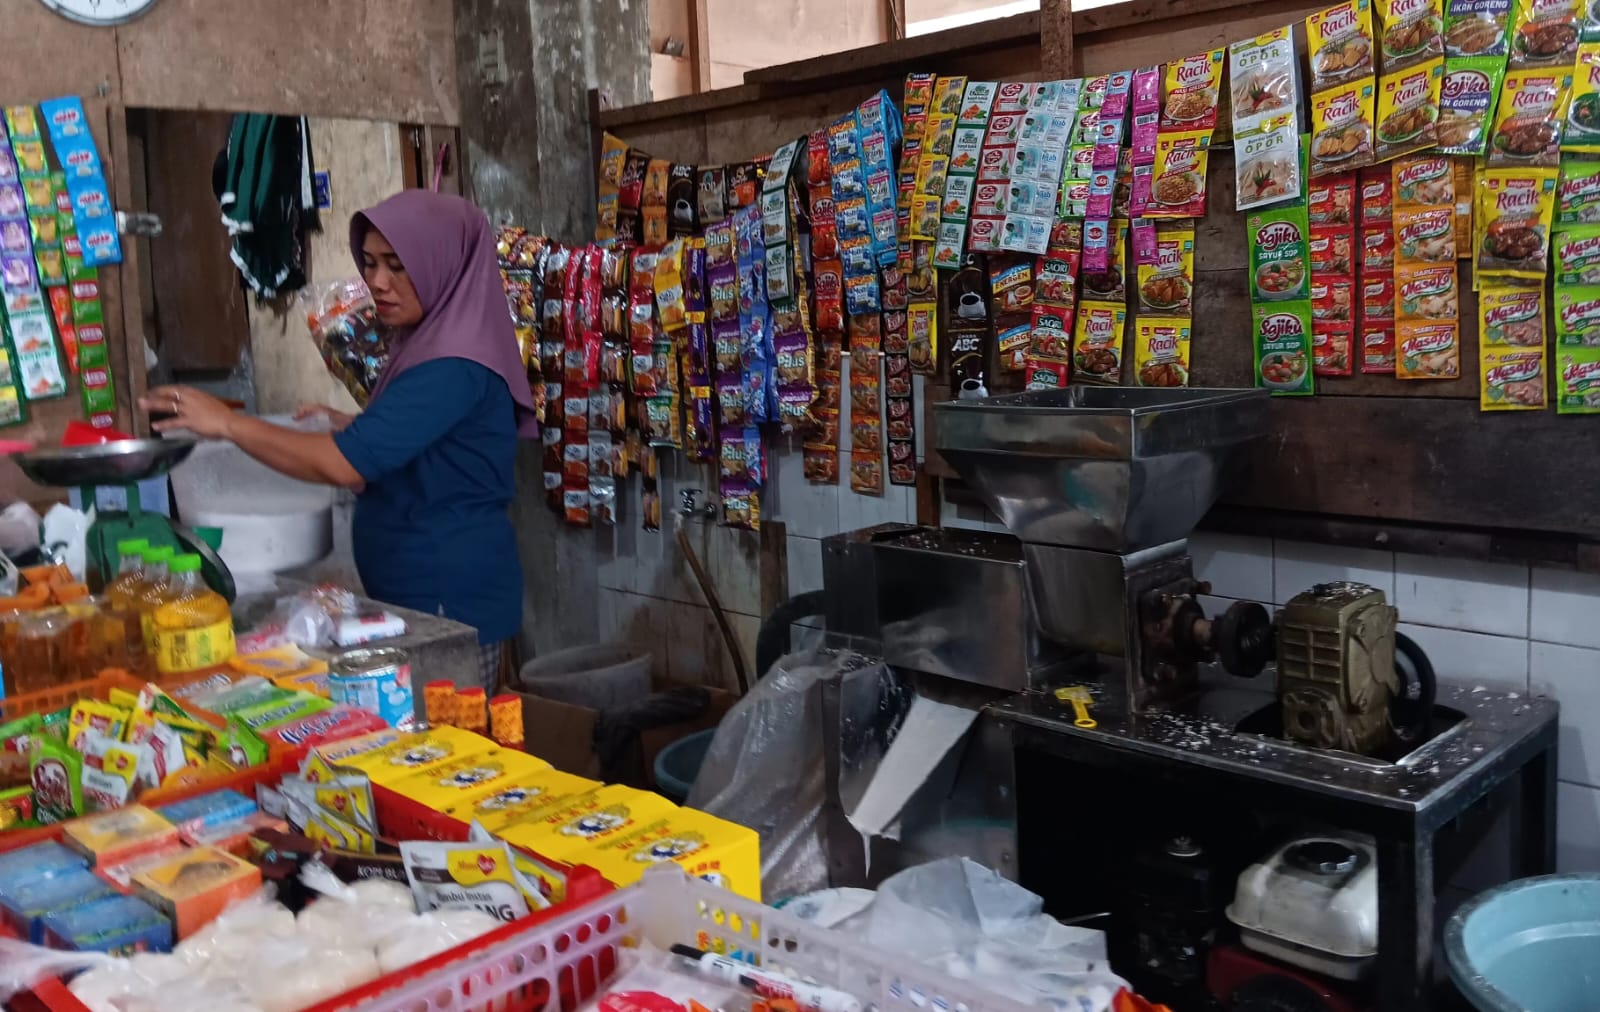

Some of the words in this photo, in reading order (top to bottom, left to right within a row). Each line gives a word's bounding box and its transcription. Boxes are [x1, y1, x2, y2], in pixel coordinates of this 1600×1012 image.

[1391, 0, 1427, 16] Rac
[1320, 10, 1357, 38] Racik
[1239, 48, 1280, 67] OPOR
[1176, 61, 1211, 82] Racik
[1393, 78, 1429, 105] Racik
[1322, 96, 1360, 122] Racik
[1245, 136, 1284, 154] OPOR
[1164, 149, 1197, 165] Racik
[1399, 157, 1447, 184] Masako
[1496, 189, 1539, 210] Racik
[1256, 226, 1301, 251] Sajiku
[1400, 216, 1448, 241] Masako
[1044, 262, 1068, 273] SAORI
[995, 271, 1028, 290] ENERGEN
[1401, 272, 1450, 297] Masako
[1485, 299, 1537, 324] Masako
[1037, 318, 1062, 329] SAORI
[1084, 318, 1114, 334] Racik
[1260, 318, 1303, 342] Sajiku
[952, 339, 980, 352] ABC
[1001, 333, 1030, 348] ENERGE
[1149, 336, 1178, 352] Racik
[1402, 331, 1452, 354] Masako
[1033, 373, 1057, 384] SAORI
[1486, 359, 1538, 382] Masako
